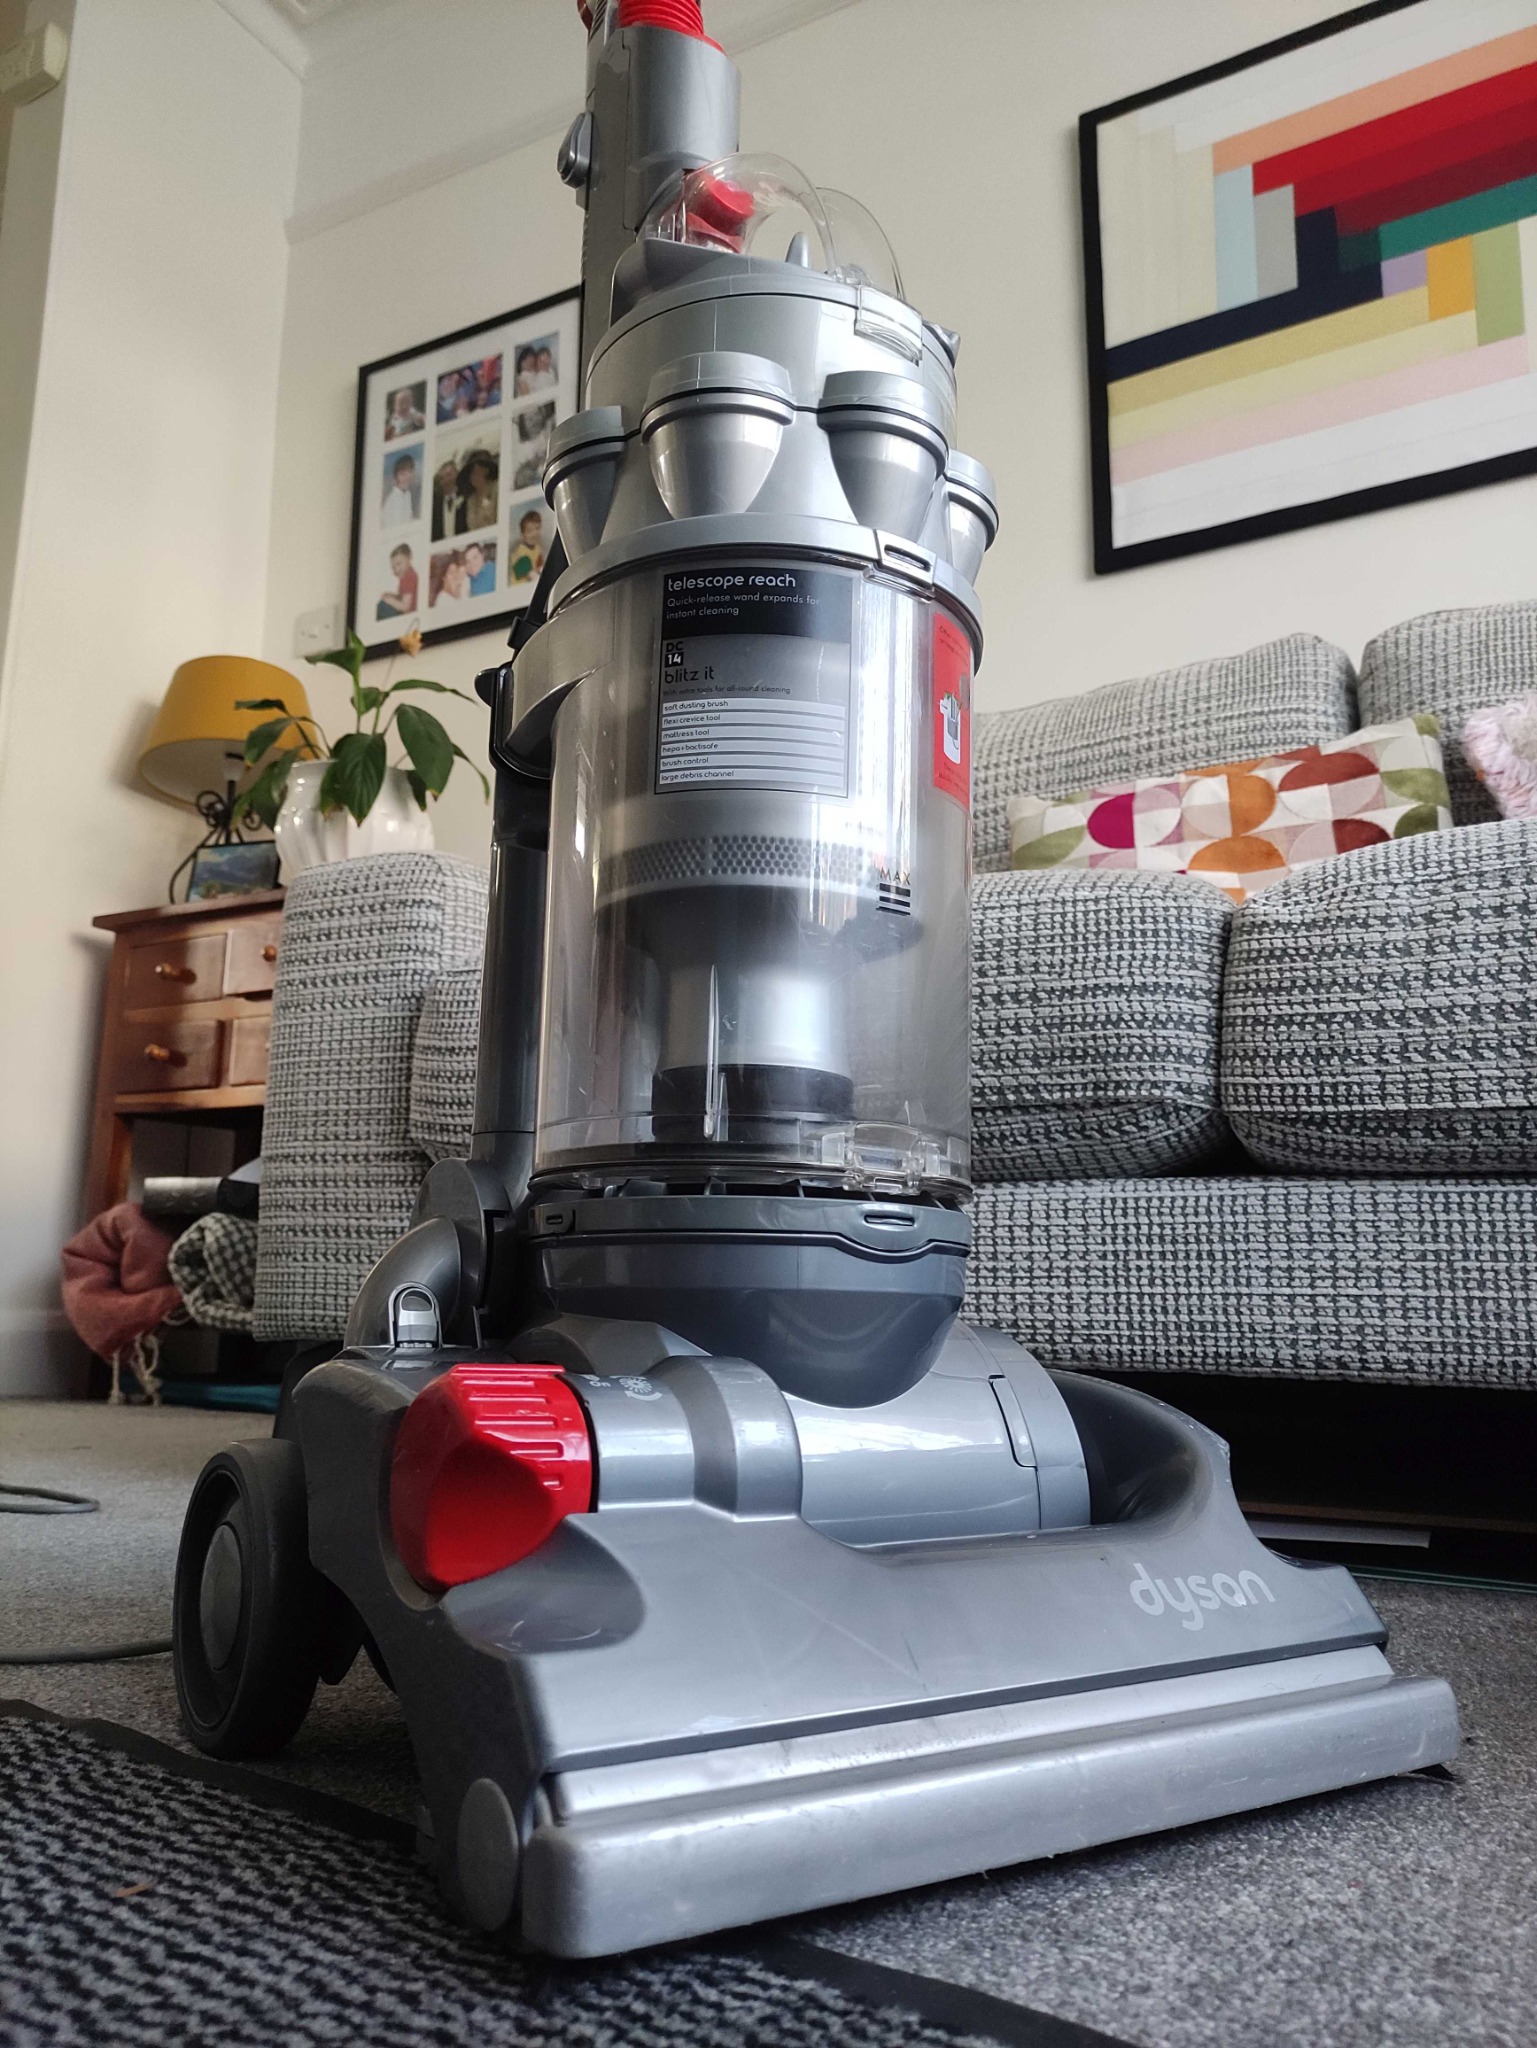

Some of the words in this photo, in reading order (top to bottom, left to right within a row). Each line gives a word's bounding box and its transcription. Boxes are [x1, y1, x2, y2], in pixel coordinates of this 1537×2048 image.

[668, 575, 745, 591] telescope
[749, 573, 796, 588] reach
[667, 594, 730, 607] Quick-release
[734, 592, 760, 601] wand
[763, 593, 803, 604] expands
[666, 608, 696, 620] instant
[699, 606, 739, 616] cleaning
[666, 641, 684, 653] DC
[667, 653, 681, 665] 14
[665, 668, 699, 684] blitz
[705, 666, 714, 680] it
[761, 685, 791, 694] cleaning
[664, 703, 678, 712] soft
[679, 701, 706, 709] dusting
[663, 717, 678, 725] flexi
[663, 731, 694, 739] mattress
[662, 759, 682, 767] brush
[683, 757, 709, 765] control
[661, 774, 679, 782] large
[680, 772, 703, 780] debris
[704, 770, 735, 778] channel
[880, 866, 910, 886] MAX
[1129, 1562, 1276, 1631] dyson
